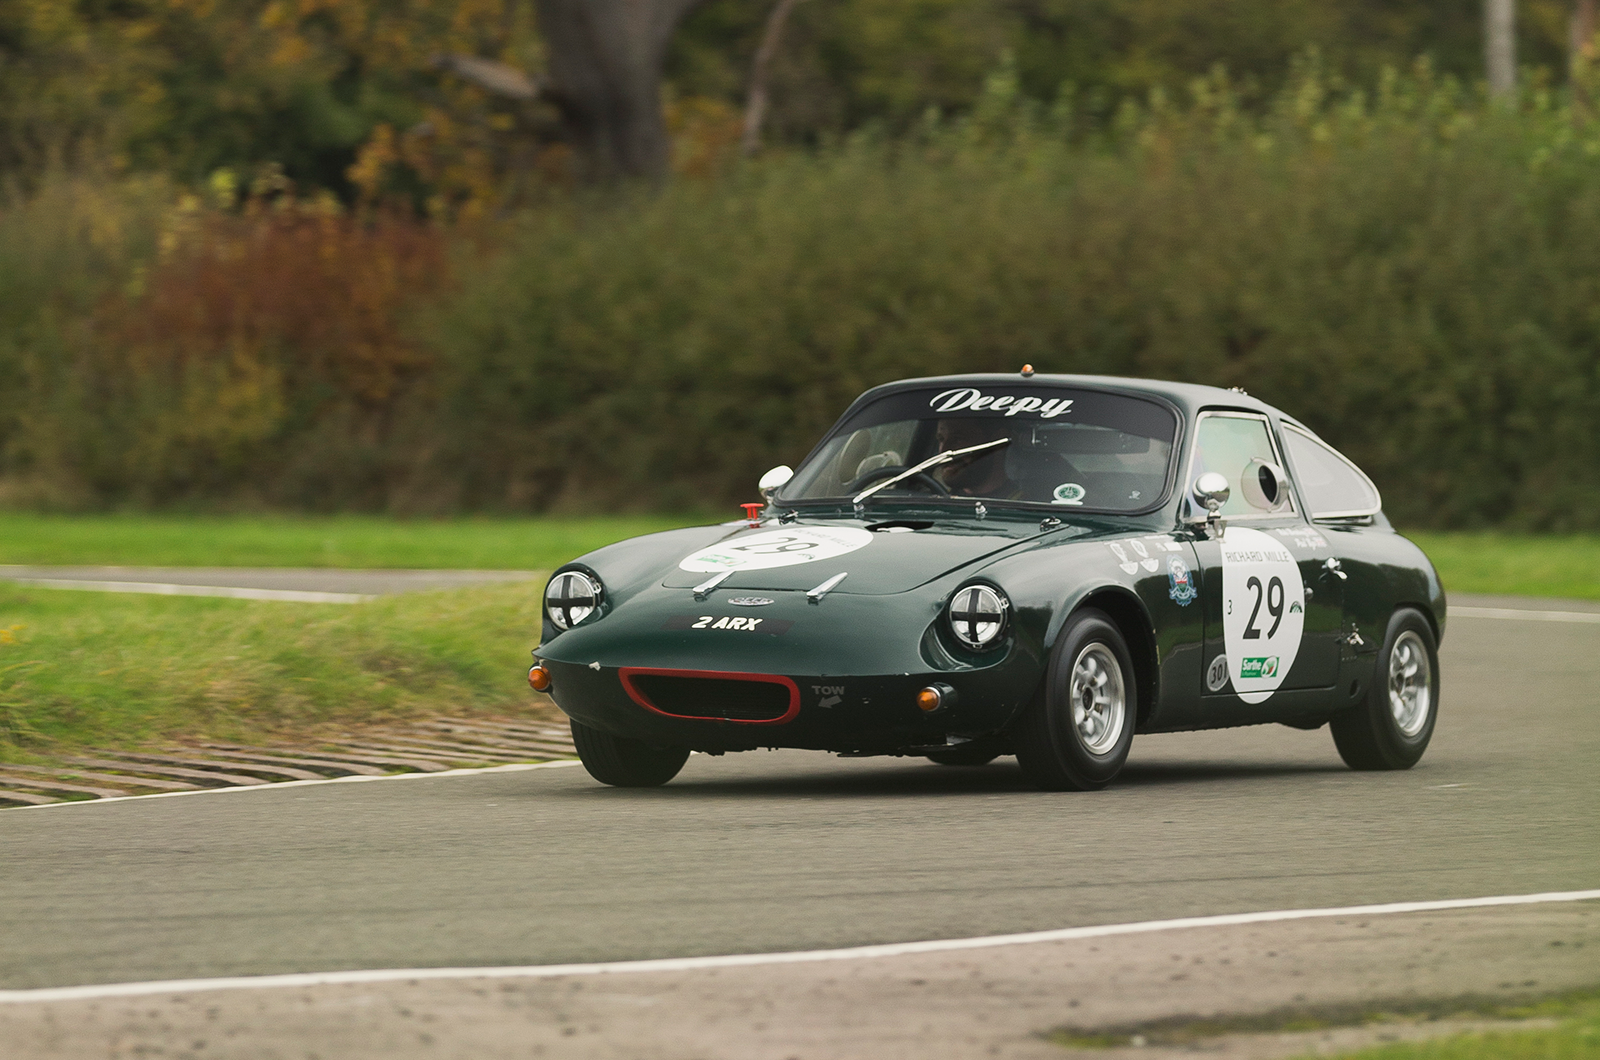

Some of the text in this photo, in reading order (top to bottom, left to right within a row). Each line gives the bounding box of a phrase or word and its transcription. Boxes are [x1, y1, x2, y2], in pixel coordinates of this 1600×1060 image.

[930, 388, 1074, 418] Deepy
[731, 537, 819, 554] 29
[1225, 551, 1290, 563] RICHARD MILLE
[1227, 600, 1233, 615] 3
[1243, 576, 1285, 640] 29
[691, 616, 763, 631] 2 ARX
[811, 685, 845, 695] TOW
